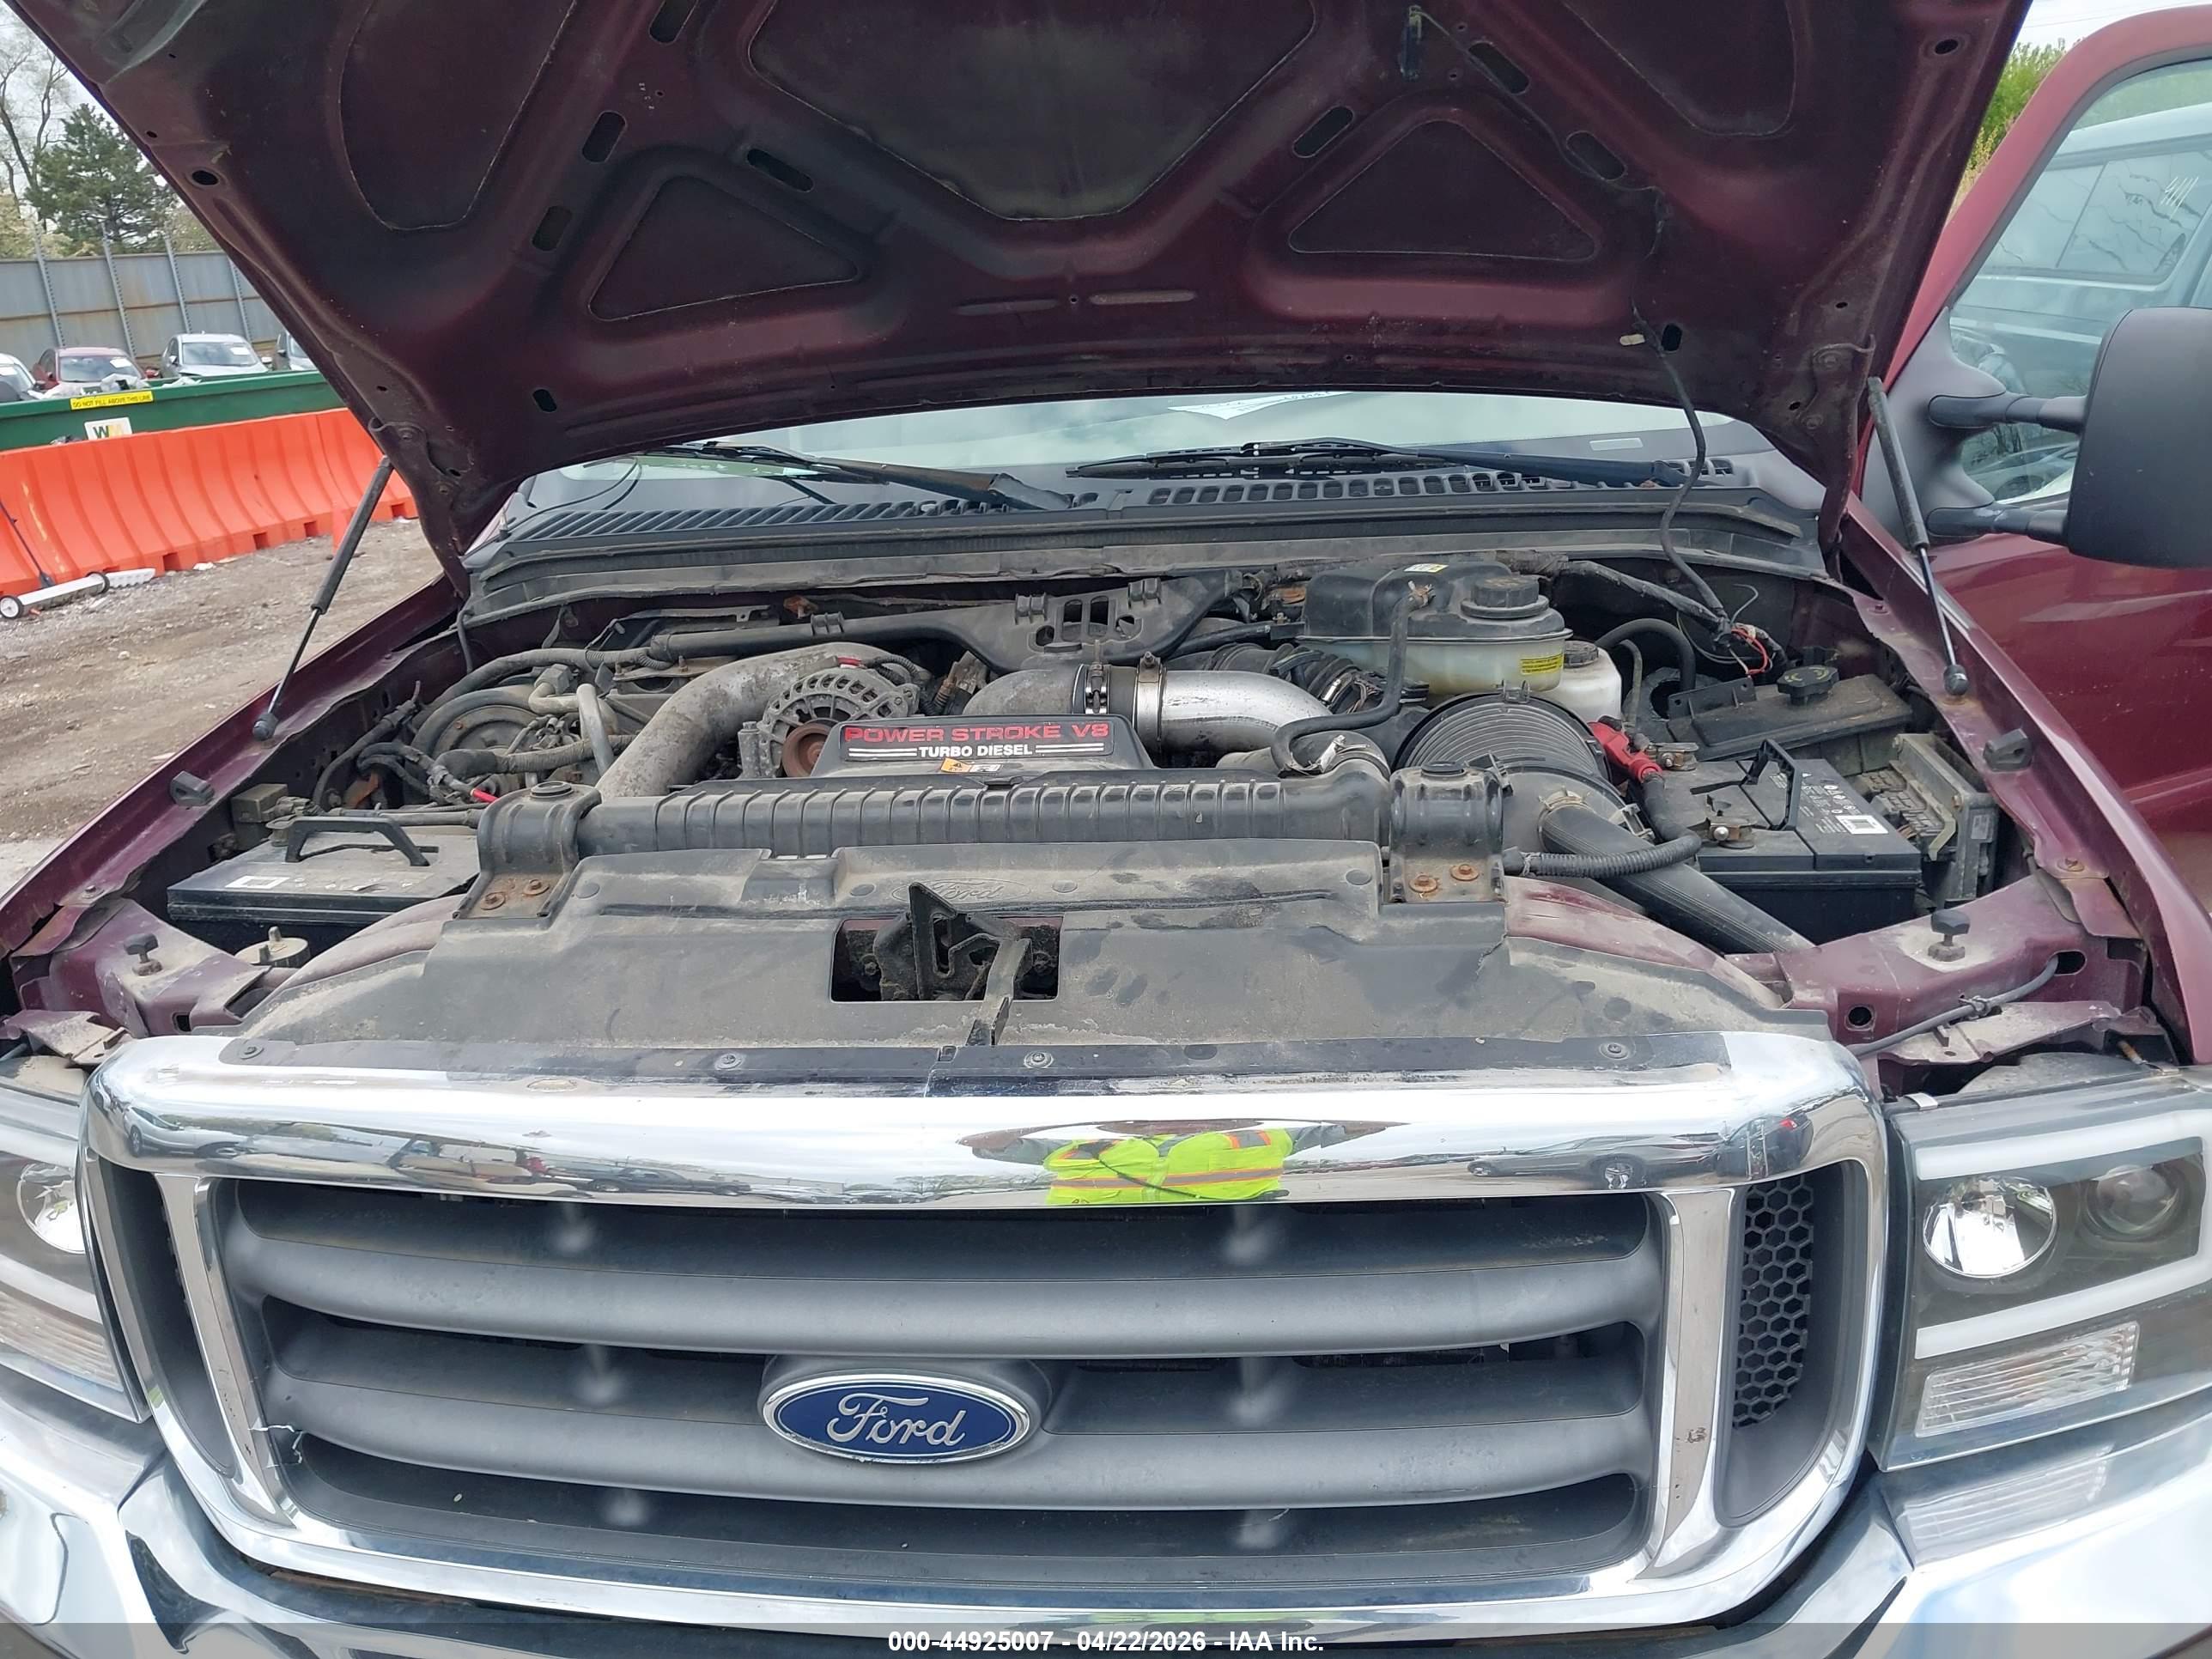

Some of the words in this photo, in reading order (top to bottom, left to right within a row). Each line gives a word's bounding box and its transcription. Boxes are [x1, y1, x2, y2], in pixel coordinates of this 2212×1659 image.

[844, 727, 944, 743] POWER
[951, 724, 1061, 742] STROKE
[1072, 722, 1109, 738] V8
[919, 746, 973, 758] TURBO
[977, 744, 1033, 757] DIESEL
[826, 1392, 967, 1447] Ford
